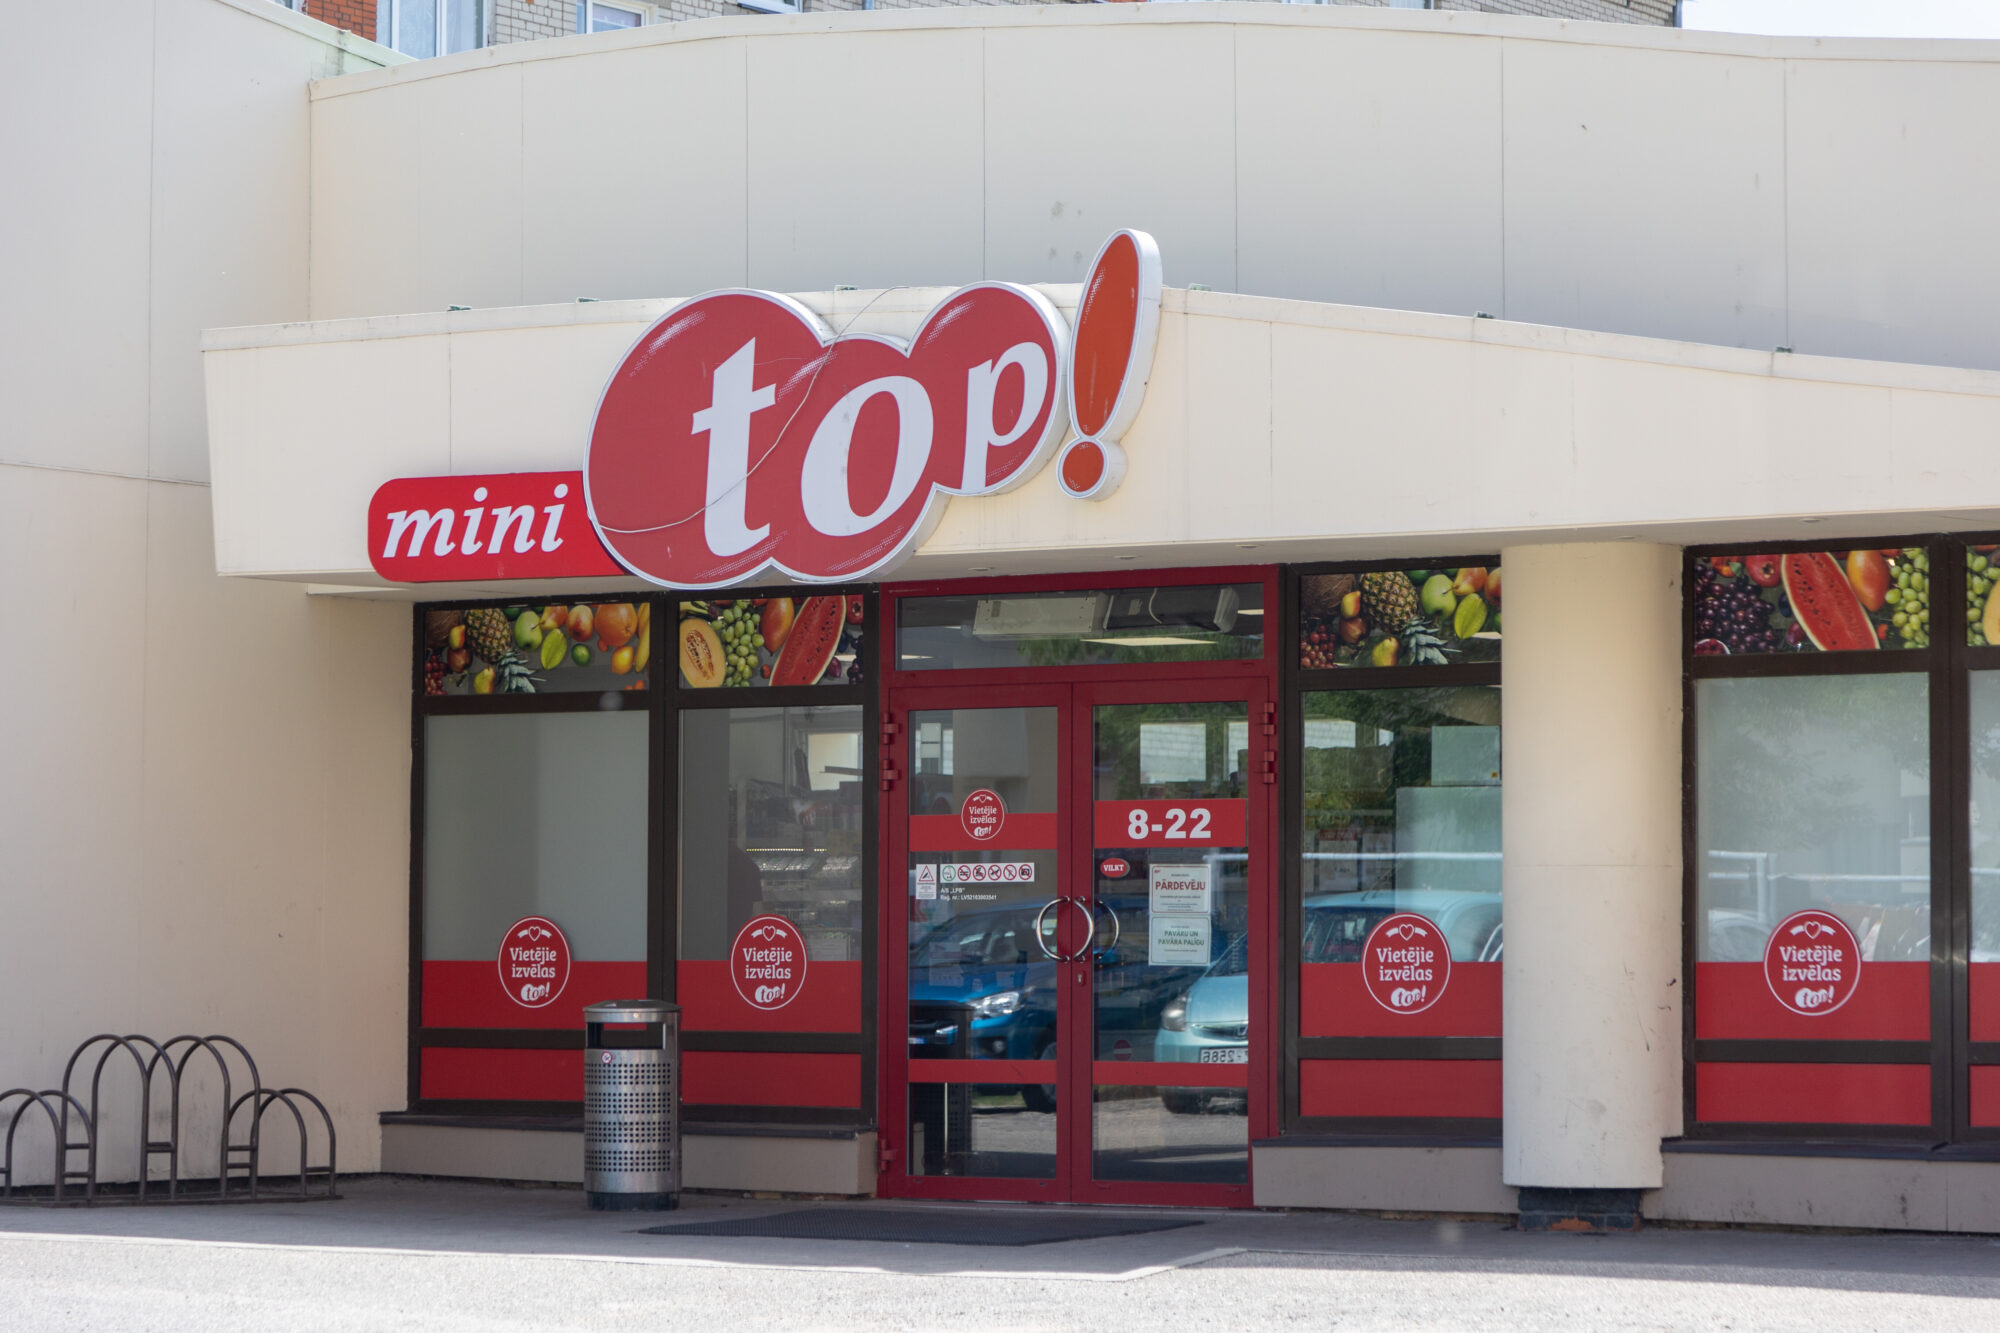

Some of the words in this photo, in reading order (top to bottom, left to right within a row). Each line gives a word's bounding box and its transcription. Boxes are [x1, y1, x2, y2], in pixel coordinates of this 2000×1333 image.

[381, 482, 570, 559] mini
[1128, 808, 1211, 839] 8-22
[1103, 864, 1125, 872] VILKT
[1155, 878, 1206, 890] PĀRDEVĒJU
[509, 947, 557, 965] Vietējie
[743, 947, 792, 965] Vietējie
[1376, 947, 1434, 966] Vietējie
[1779, 945, 1842, 966] Vietējie
[512, 964, 556, 978] izvēlas
[745, 964, 791, 979] izvēlas
[1380, 966, 1433, 981] izvēlas
[1782, 964, 1842, 981] izvēlas
